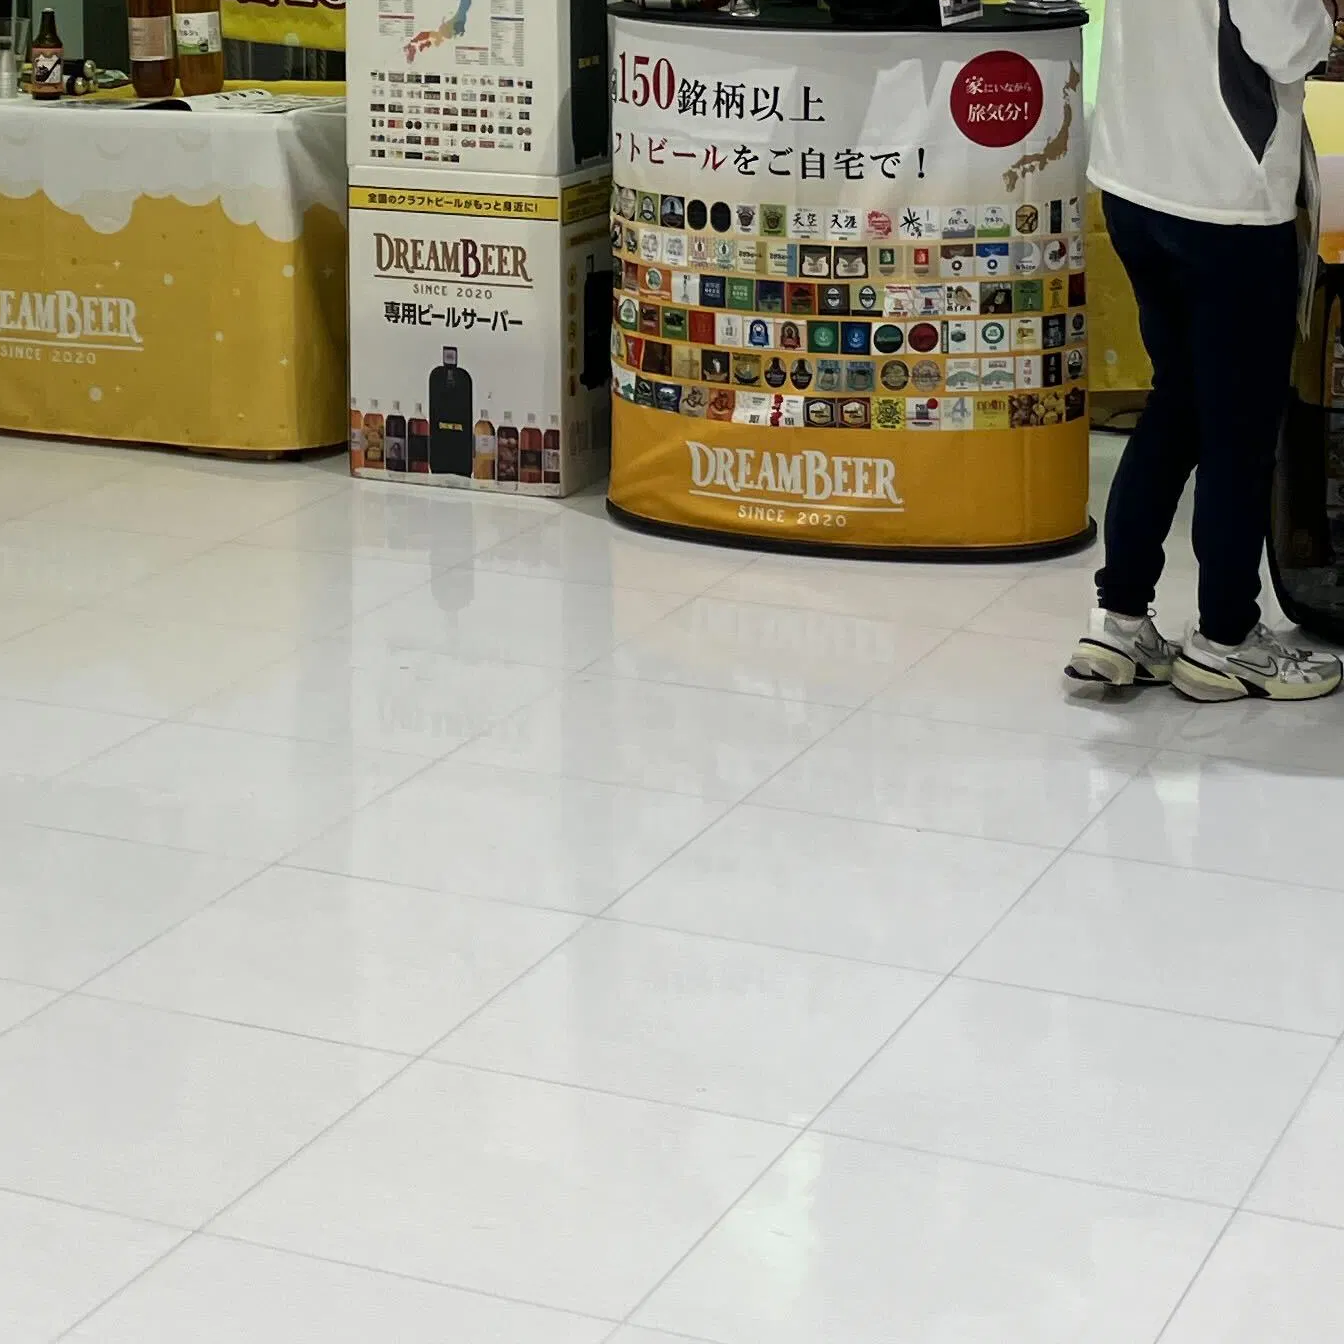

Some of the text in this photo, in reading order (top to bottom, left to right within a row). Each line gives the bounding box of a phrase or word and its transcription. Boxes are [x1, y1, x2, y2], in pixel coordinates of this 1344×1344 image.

[612, 51, 826, 122] 150銘柄以上
[967, 102, 1029, 123] 旅気分！
[368, 193, 539, 213] 全国のクラフトビールがもっと身近に！
[373, 232, 534, 283] DREAMBEER
[413, 283, 493, 300] SINCE 2020
[384, 301, 524, 332] 専用ビールサーバー
[0, 344, 97, 365] SINCE 2020
[686, 440, 904, 504] DREAMBEER
[737, 505, 847, 528] SINCE 2020
